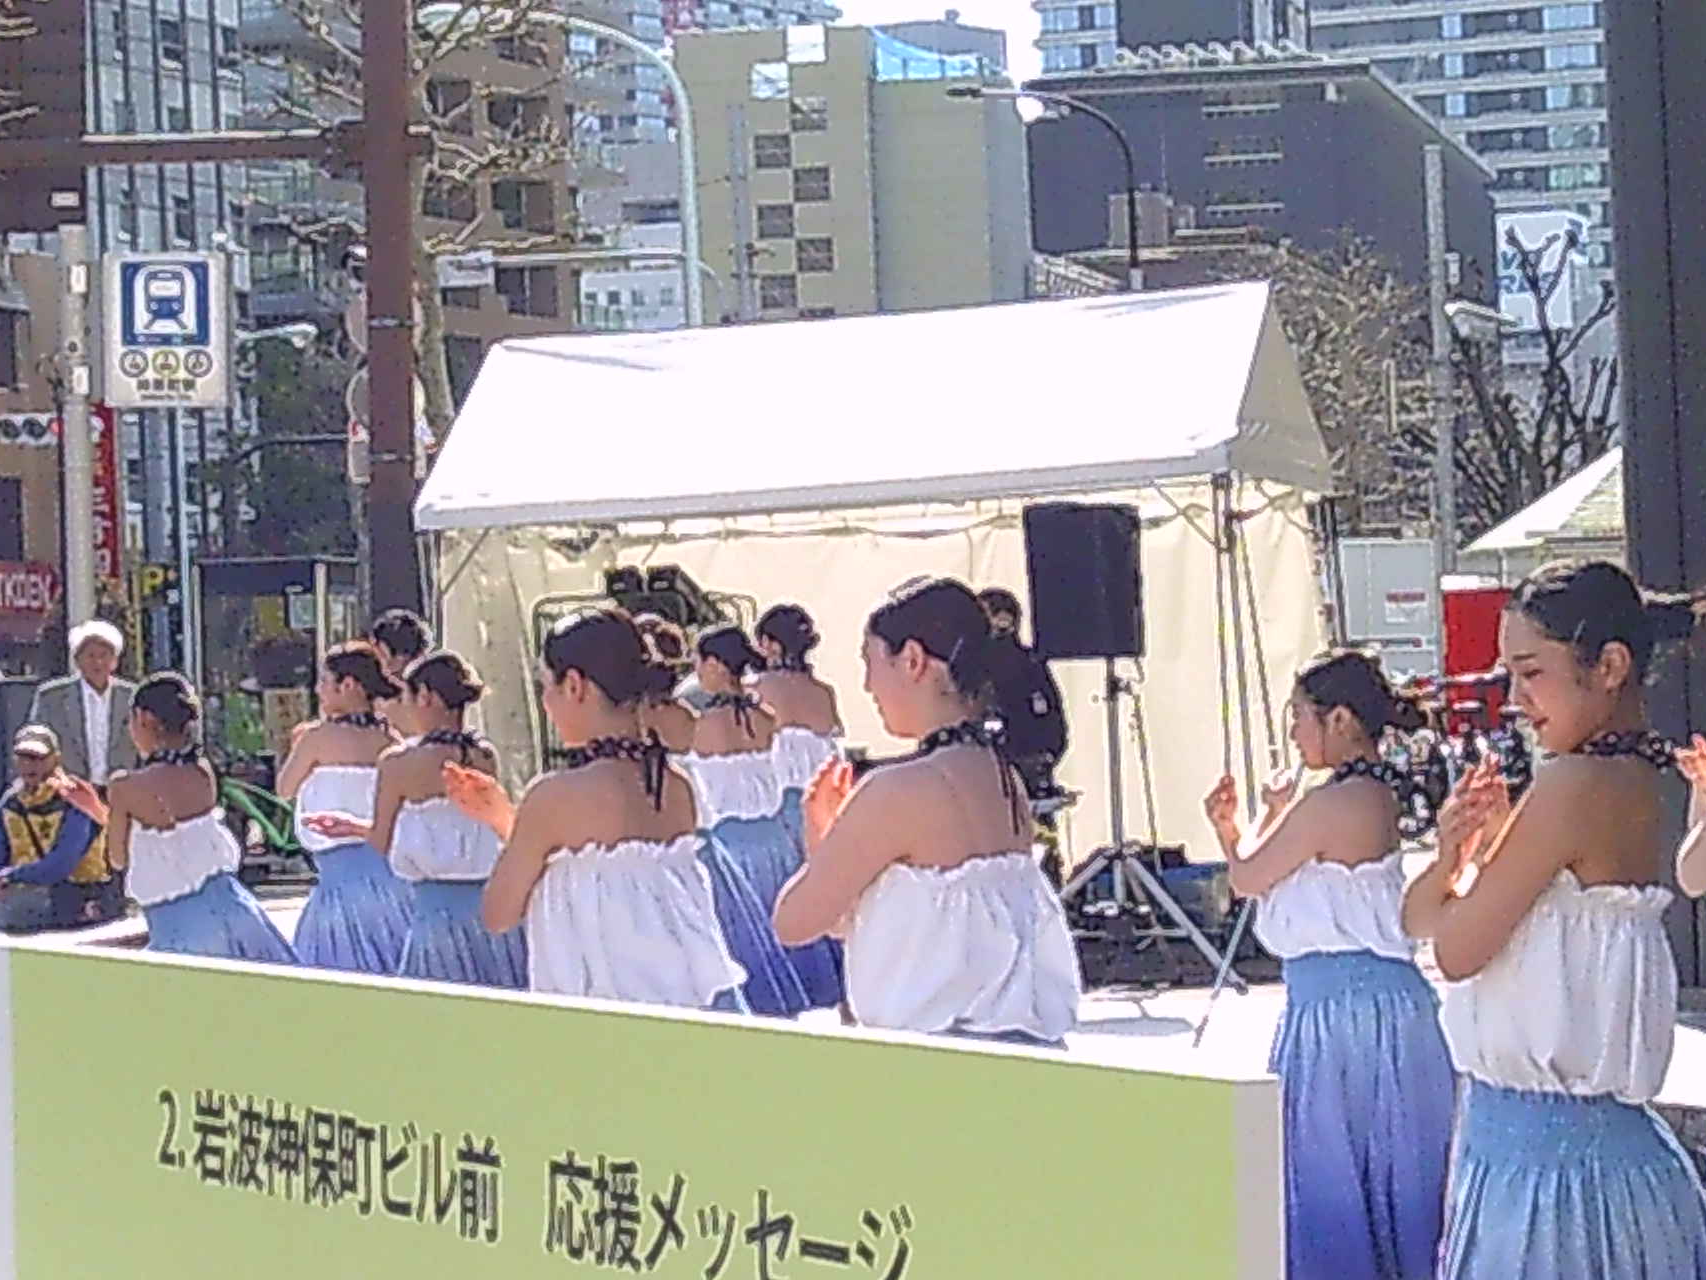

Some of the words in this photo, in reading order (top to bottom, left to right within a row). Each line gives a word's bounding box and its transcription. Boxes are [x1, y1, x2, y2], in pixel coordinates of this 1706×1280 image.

[157, 1087, 502, 1243] 2.岩波神保町ビル前
